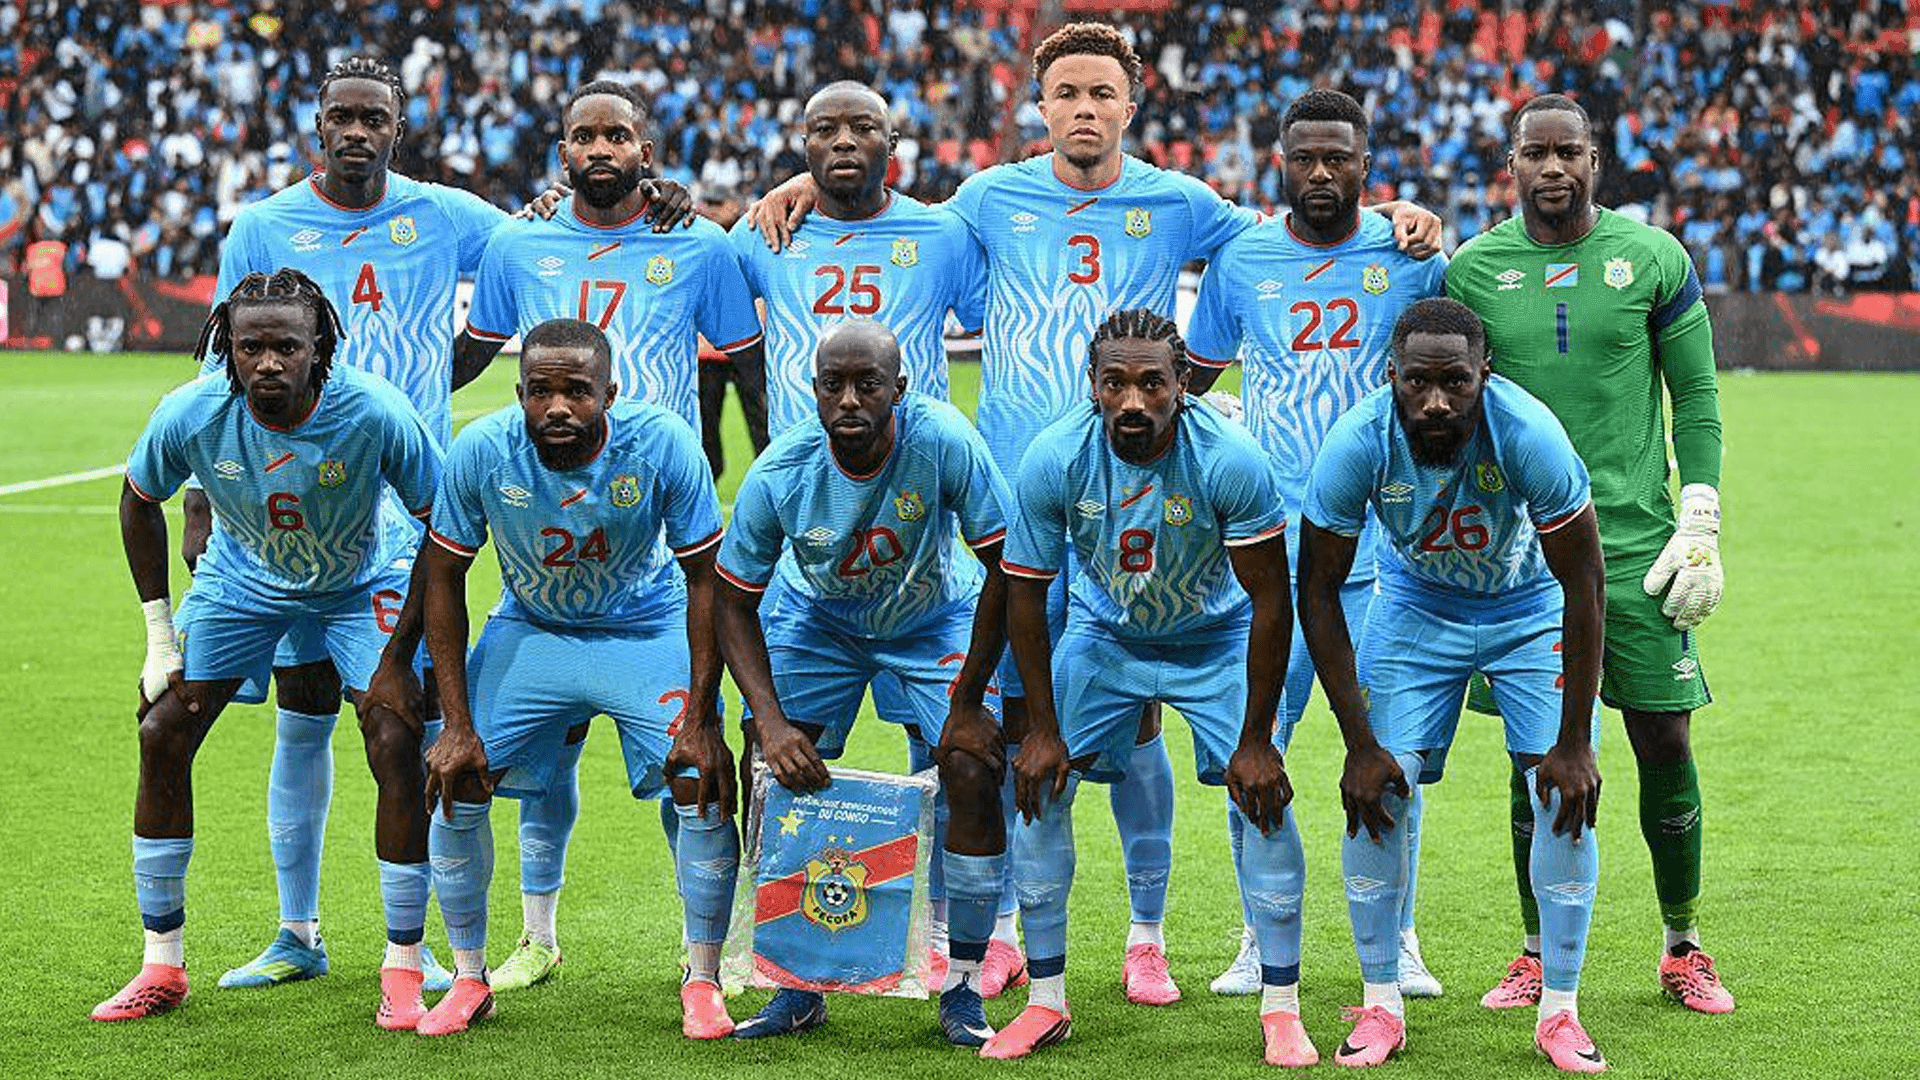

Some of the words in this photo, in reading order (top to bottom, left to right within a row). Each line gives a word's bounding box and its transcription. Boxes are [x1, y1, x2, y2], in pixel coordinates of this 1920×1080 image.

[1067, 234, 1101, 284] 3
[352, 263, 383, 311] 4
[577, 280, 627, 330] 17
[812, 265, 881, 315] 25
[1290, 298, 1361, 351] 22
[1556, 302, 1569, 357] 1
[267, 492, 304, 530] 6
[1421, 505, 1489, 552] 26
[540, 527, 610, 567] 24
[838, 526, 903, 578] 20
[1119, 529, 1153, 572] 8
[372, 589, 402, 634] 6
[658, 690, 690, 737] 2
[834, 810, 869, 824] CONGO
